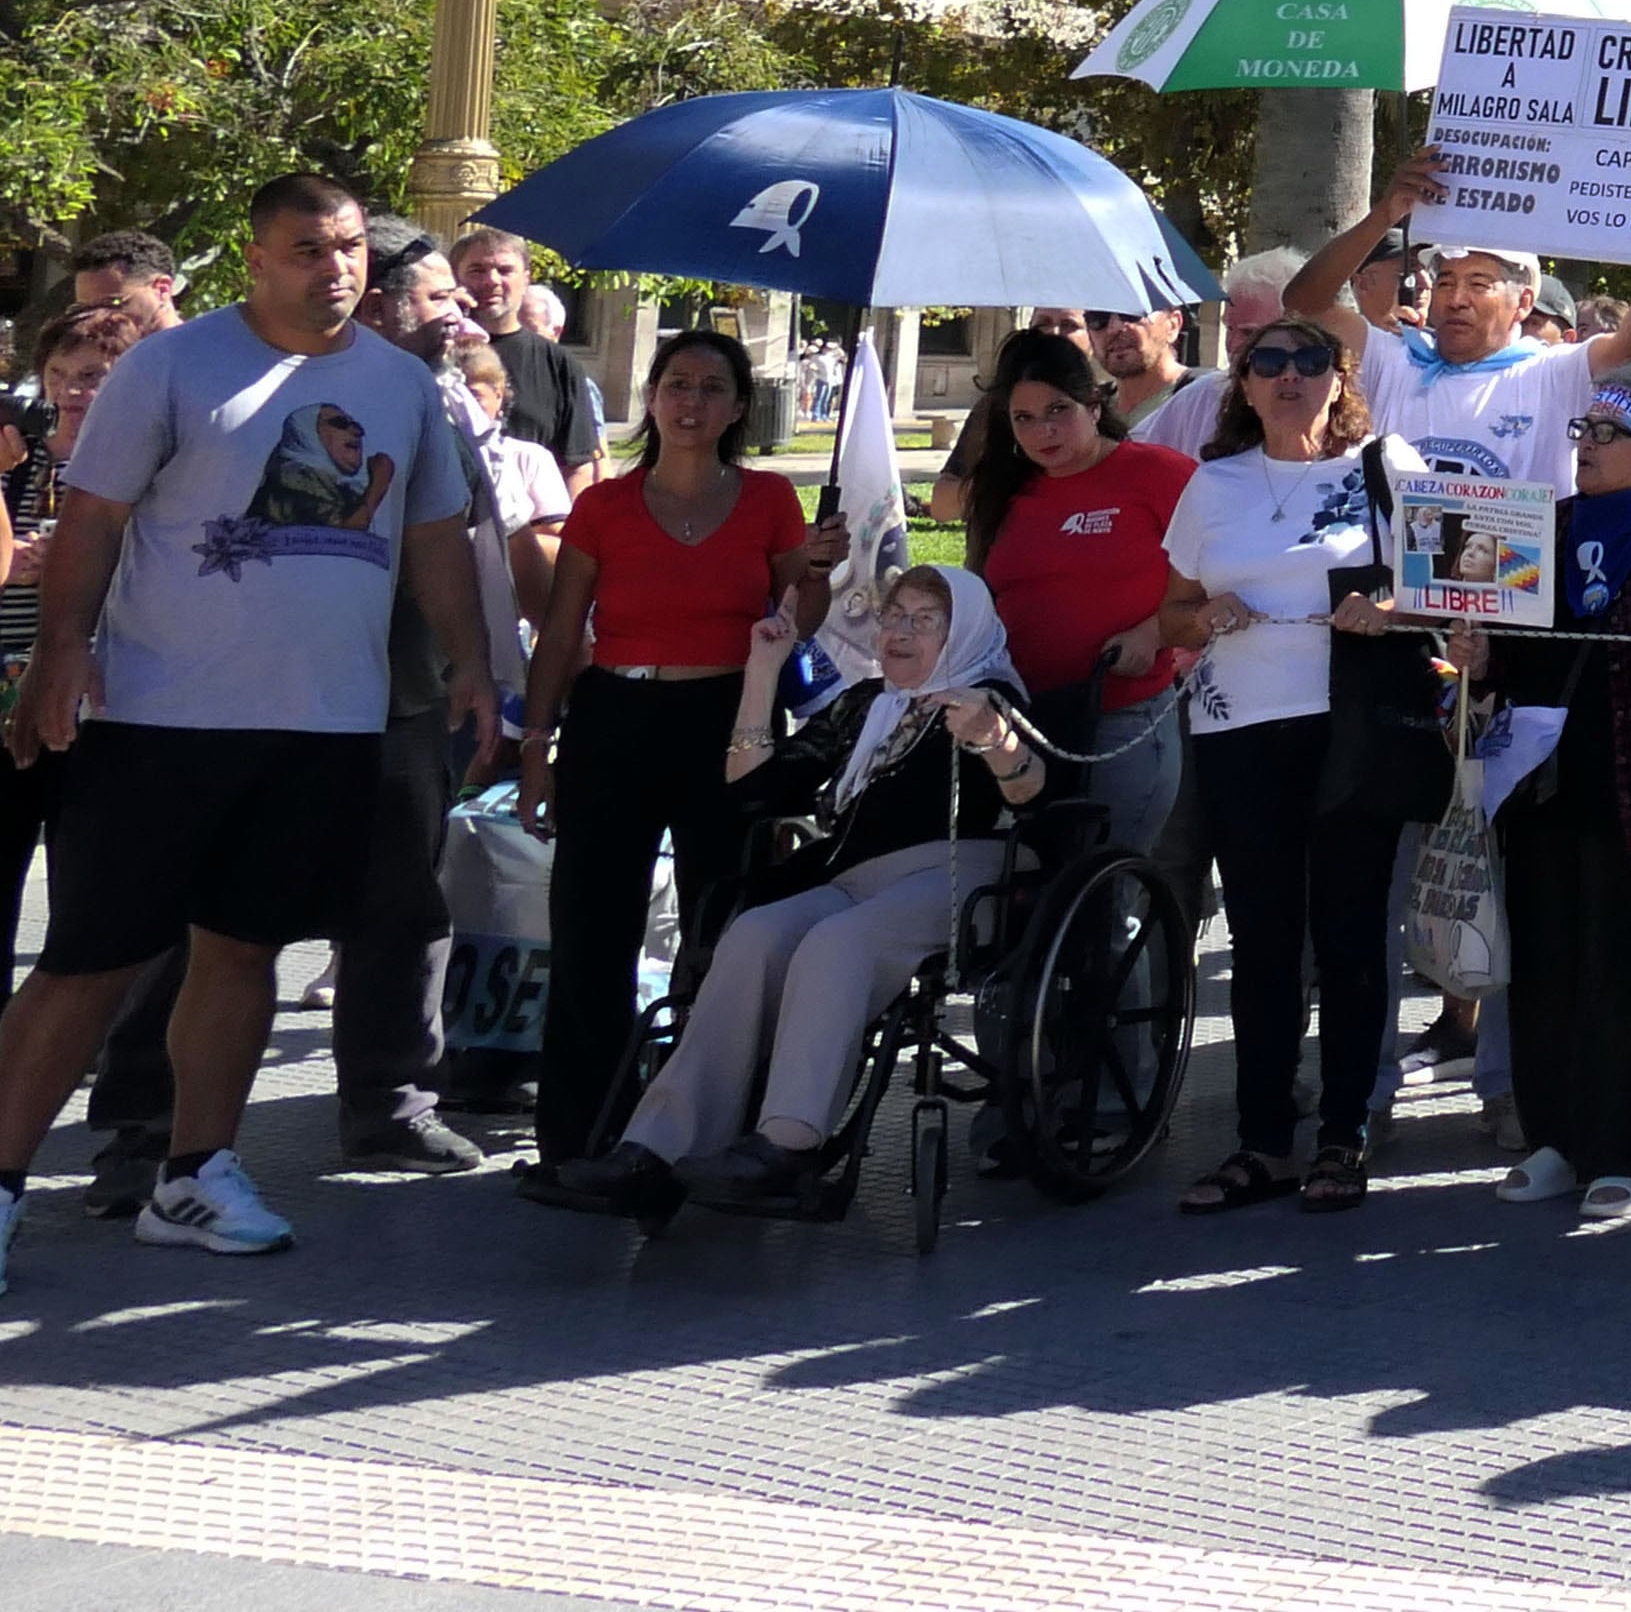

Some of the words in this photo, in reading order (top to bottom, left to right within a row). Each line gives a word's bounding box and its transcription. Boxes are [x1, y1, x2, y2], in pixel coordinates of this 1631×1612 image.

[1276, 2, 1349, 20] CASA
[1286, 30, 1326, 49] DE
[1454, 22, 1576, 60] LIBERTAD
[1235, 59, 1360, 78] MONEDA
[1501, 61, 1516, 88] A
[1436, 92, 1521, 120] MILAGRO
[1526, 99, 1574, 124] SALA
[1433, 127, 1552, 153] DESOCUPACIÓN:
[1456, 187, 1536, 214] ESTADO
[1566, 208, 1600, 226] VOS
[1604, 213, 1626, 228] LO
